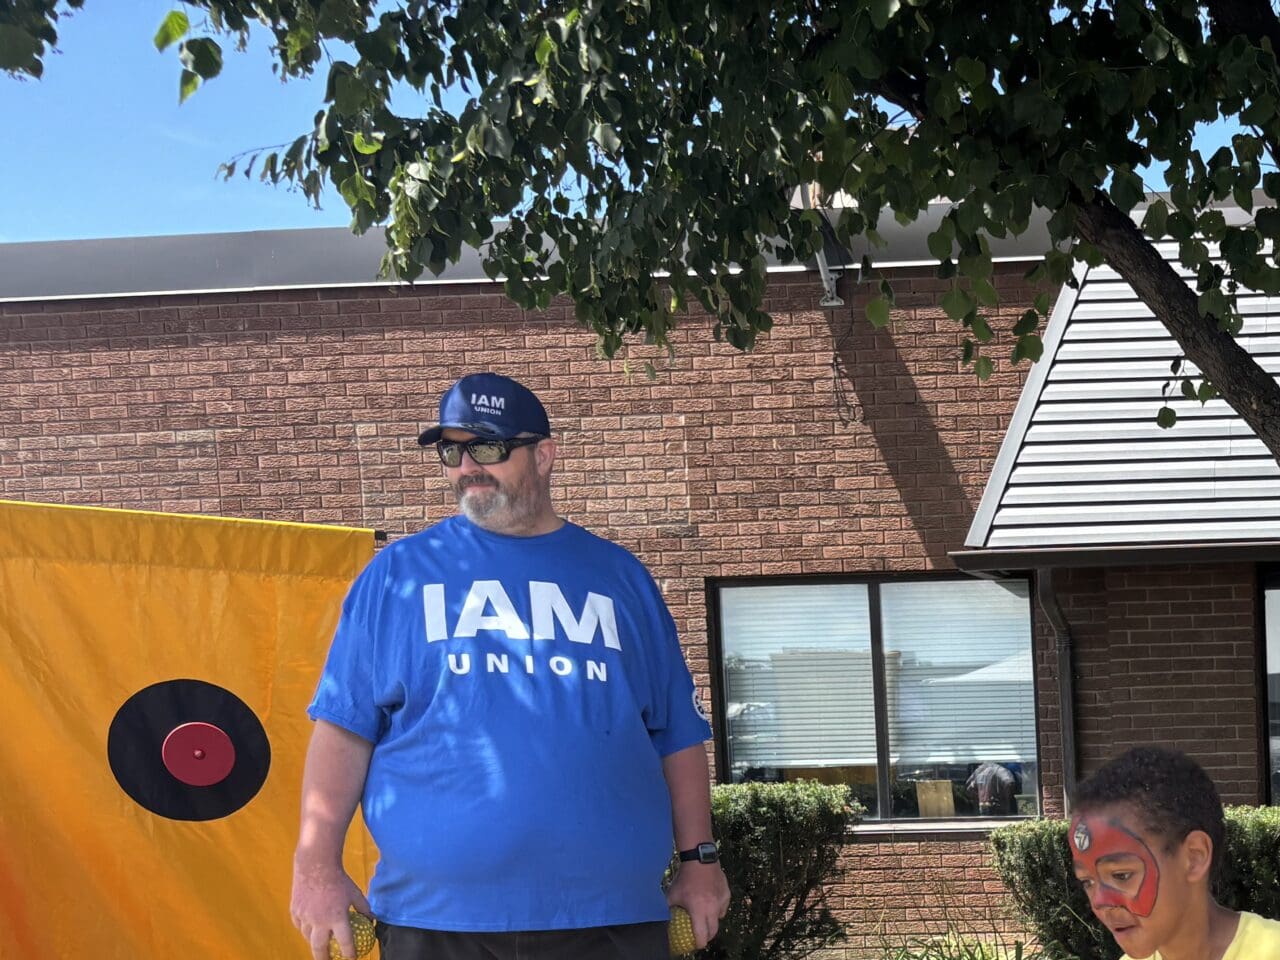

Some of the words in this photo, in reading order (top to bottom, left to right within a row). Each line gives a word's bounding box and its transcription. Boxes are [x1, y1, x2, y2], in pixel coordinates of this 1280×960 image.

[471, 393, 505, 409] IAM
[474, 406, 502, 416] UNION
[423, 580, 622, 651] IAM
[448, 653, 607, 682] UNION
